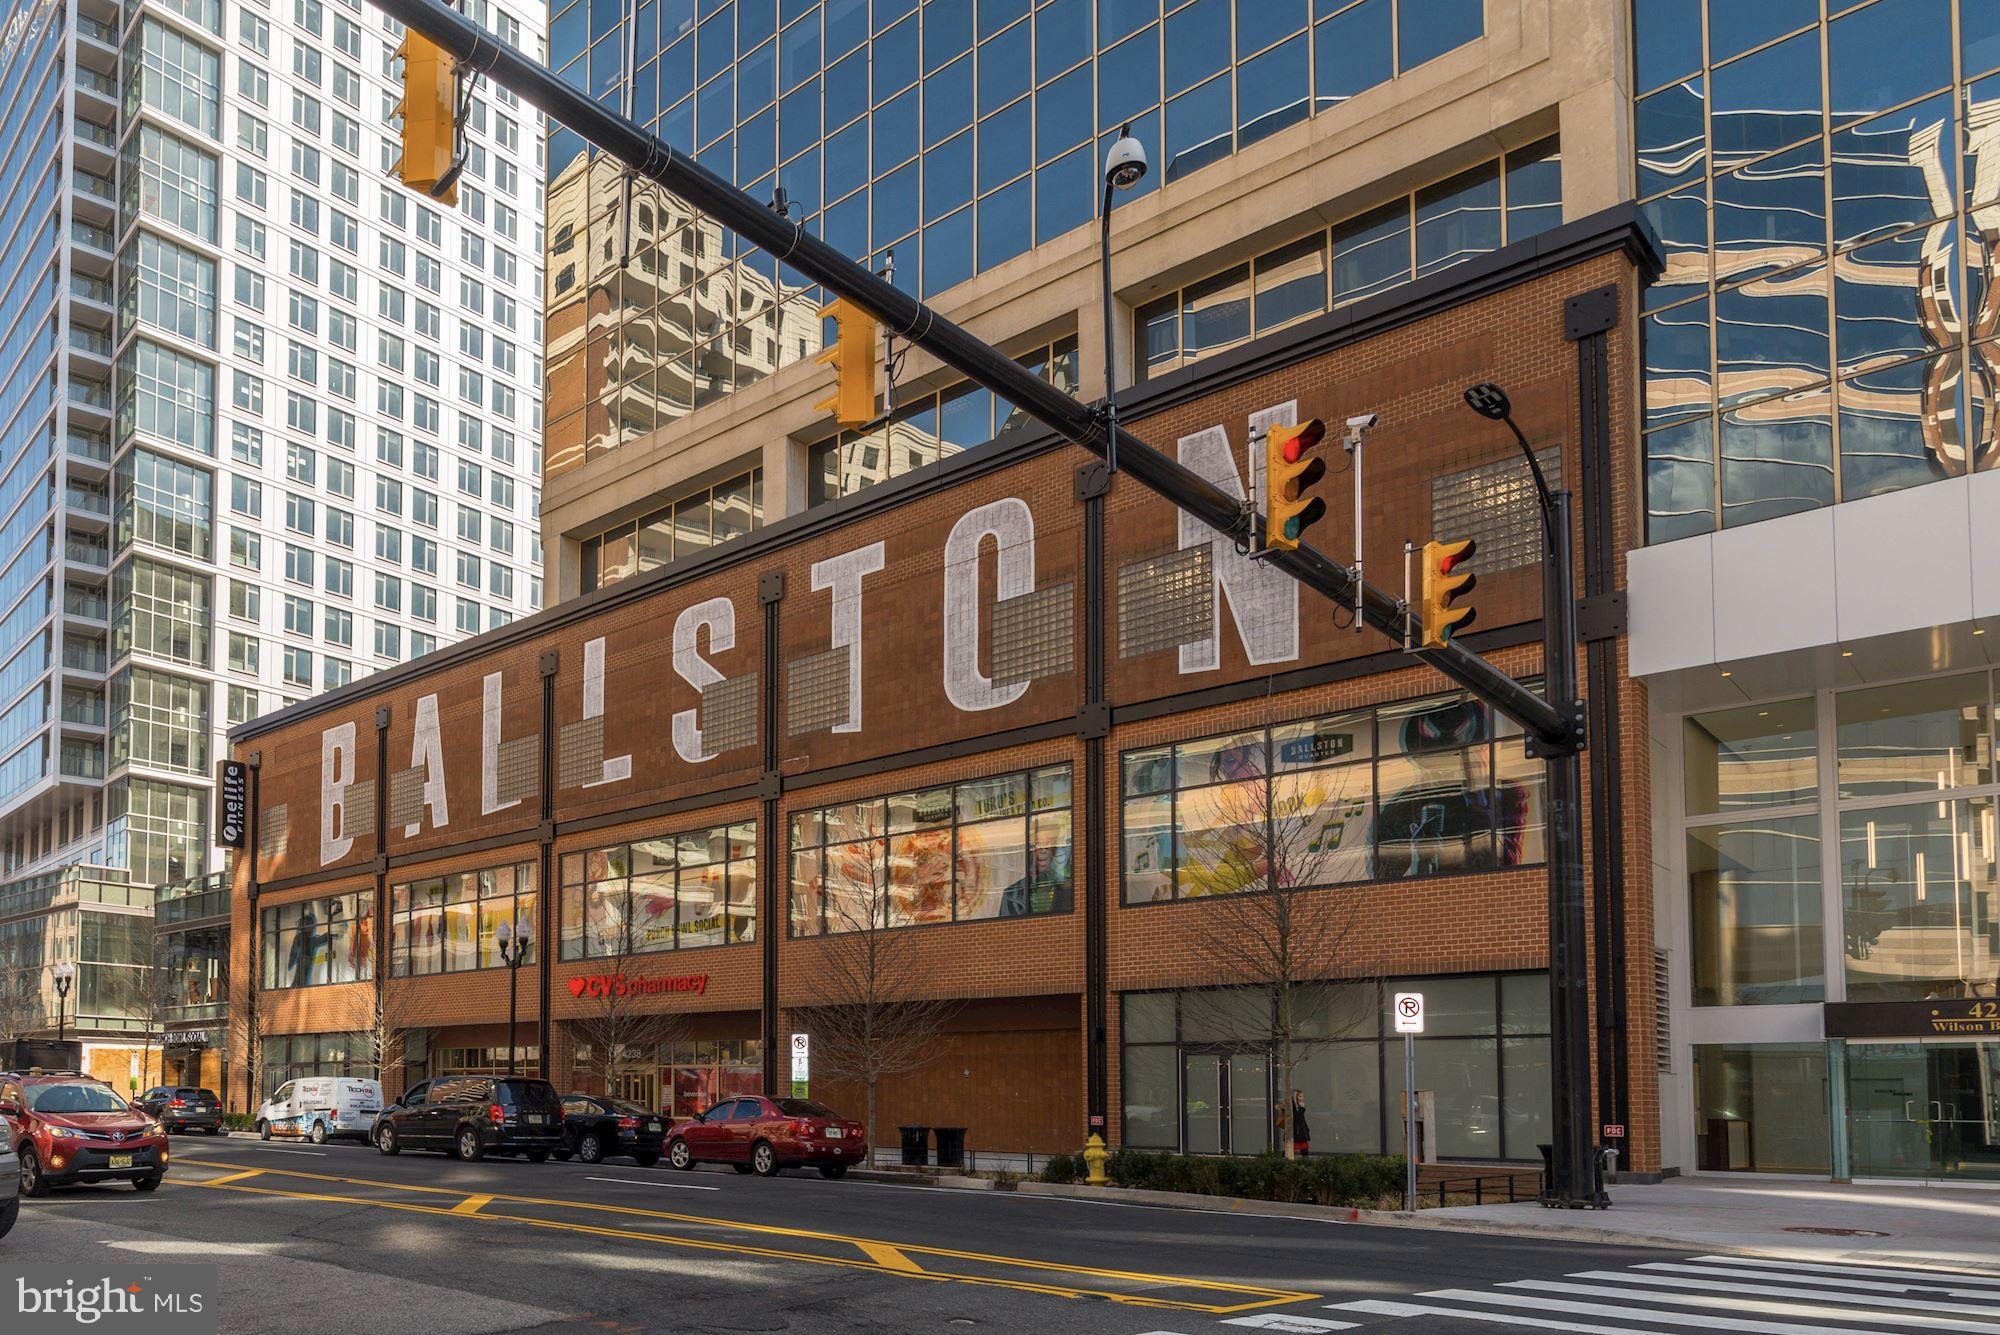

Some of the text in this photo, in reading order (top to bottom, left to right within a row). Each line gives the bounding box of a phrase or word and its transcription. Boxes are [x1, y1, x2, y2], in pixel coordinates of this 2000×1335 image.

[318, 399, 1301, 867] BALLSTON
[1290, 738, 1343, 756] BALLSTON
[1298, 750, 1335, 760] QUARTER
[237, 778, 245, 833] FITNESS
[694, 917, 721, 932] SOCIAL
[586, 972, 708, 998] CVS pharmacy
[1932, 1021, 1984, 1032] Wilson
[1606, 1127, 1622, 1135] FDC
